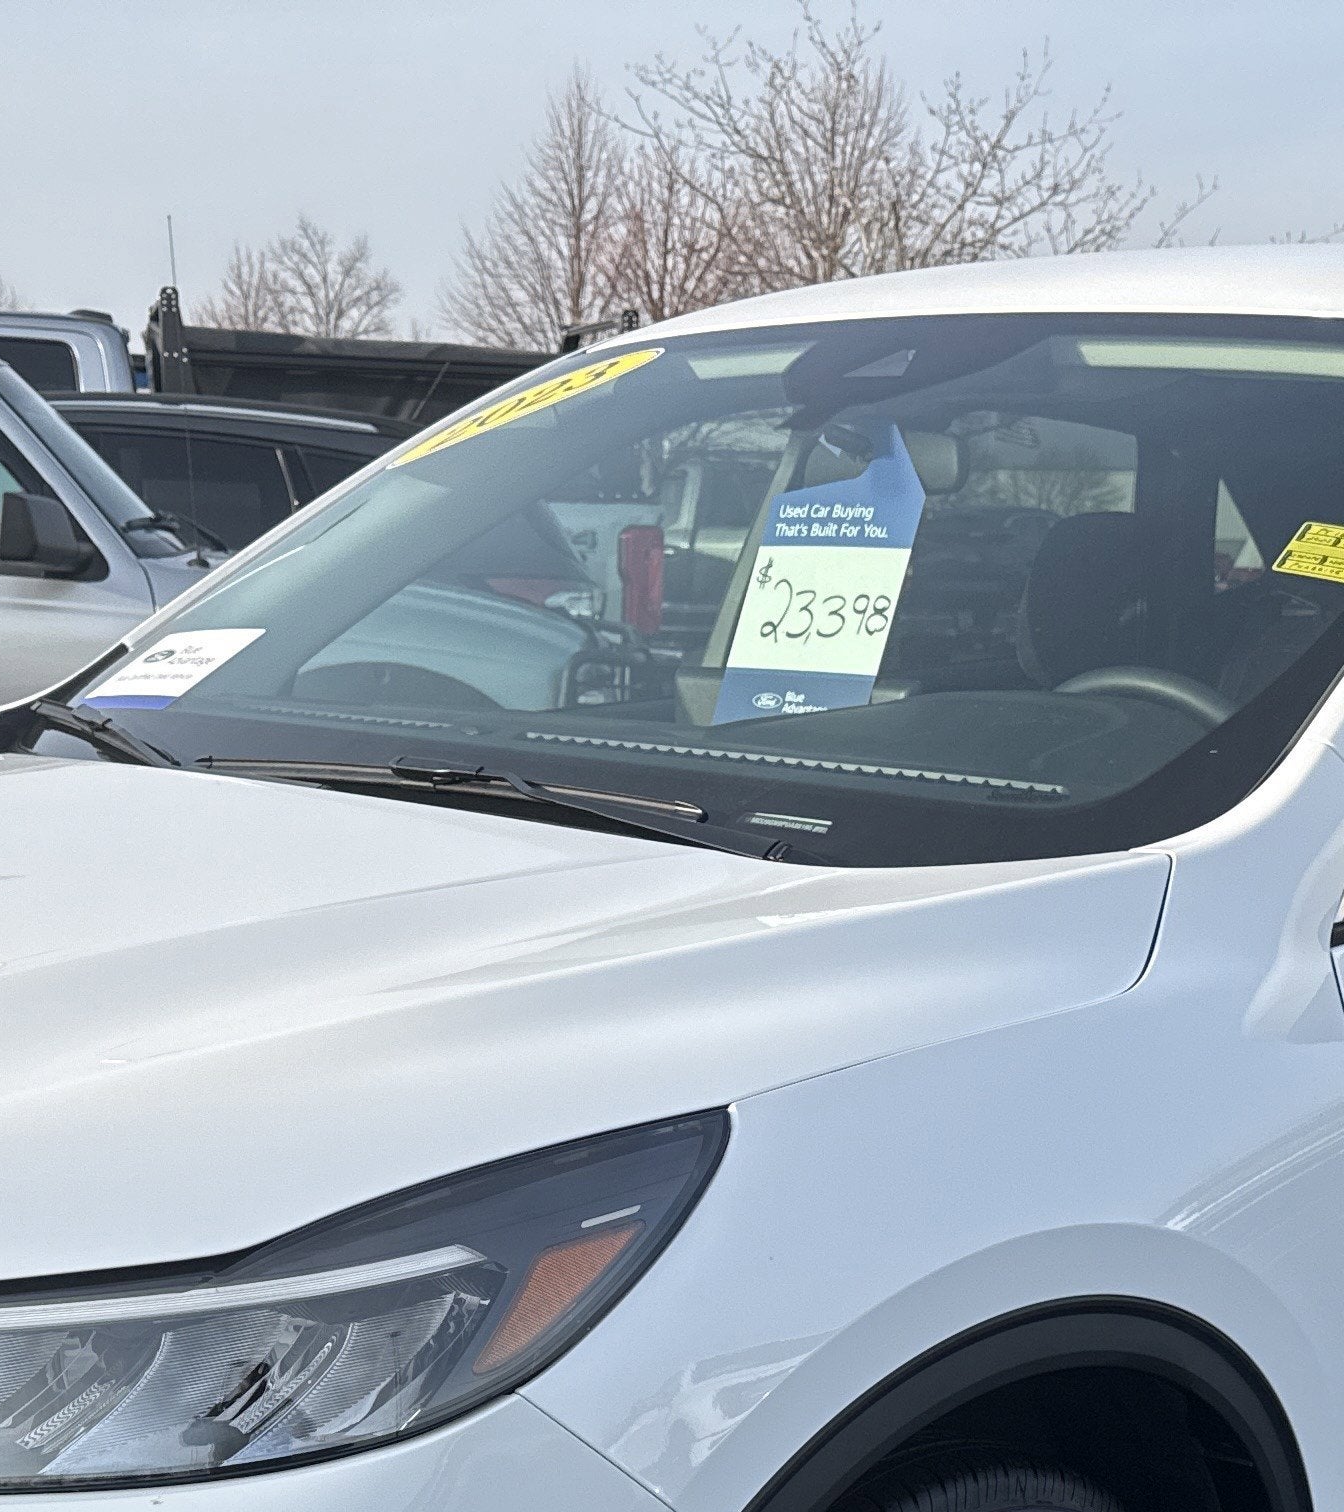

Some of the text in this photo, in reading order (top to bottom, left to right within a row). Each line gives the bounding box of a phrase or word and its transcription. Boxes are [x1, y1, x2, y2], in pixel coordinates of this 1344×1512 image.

[429, 361, 621, 452] 2023
[779, 503, 874, 521] Used Car Buying
[775, 522, 888, 538] That's Built For You.
